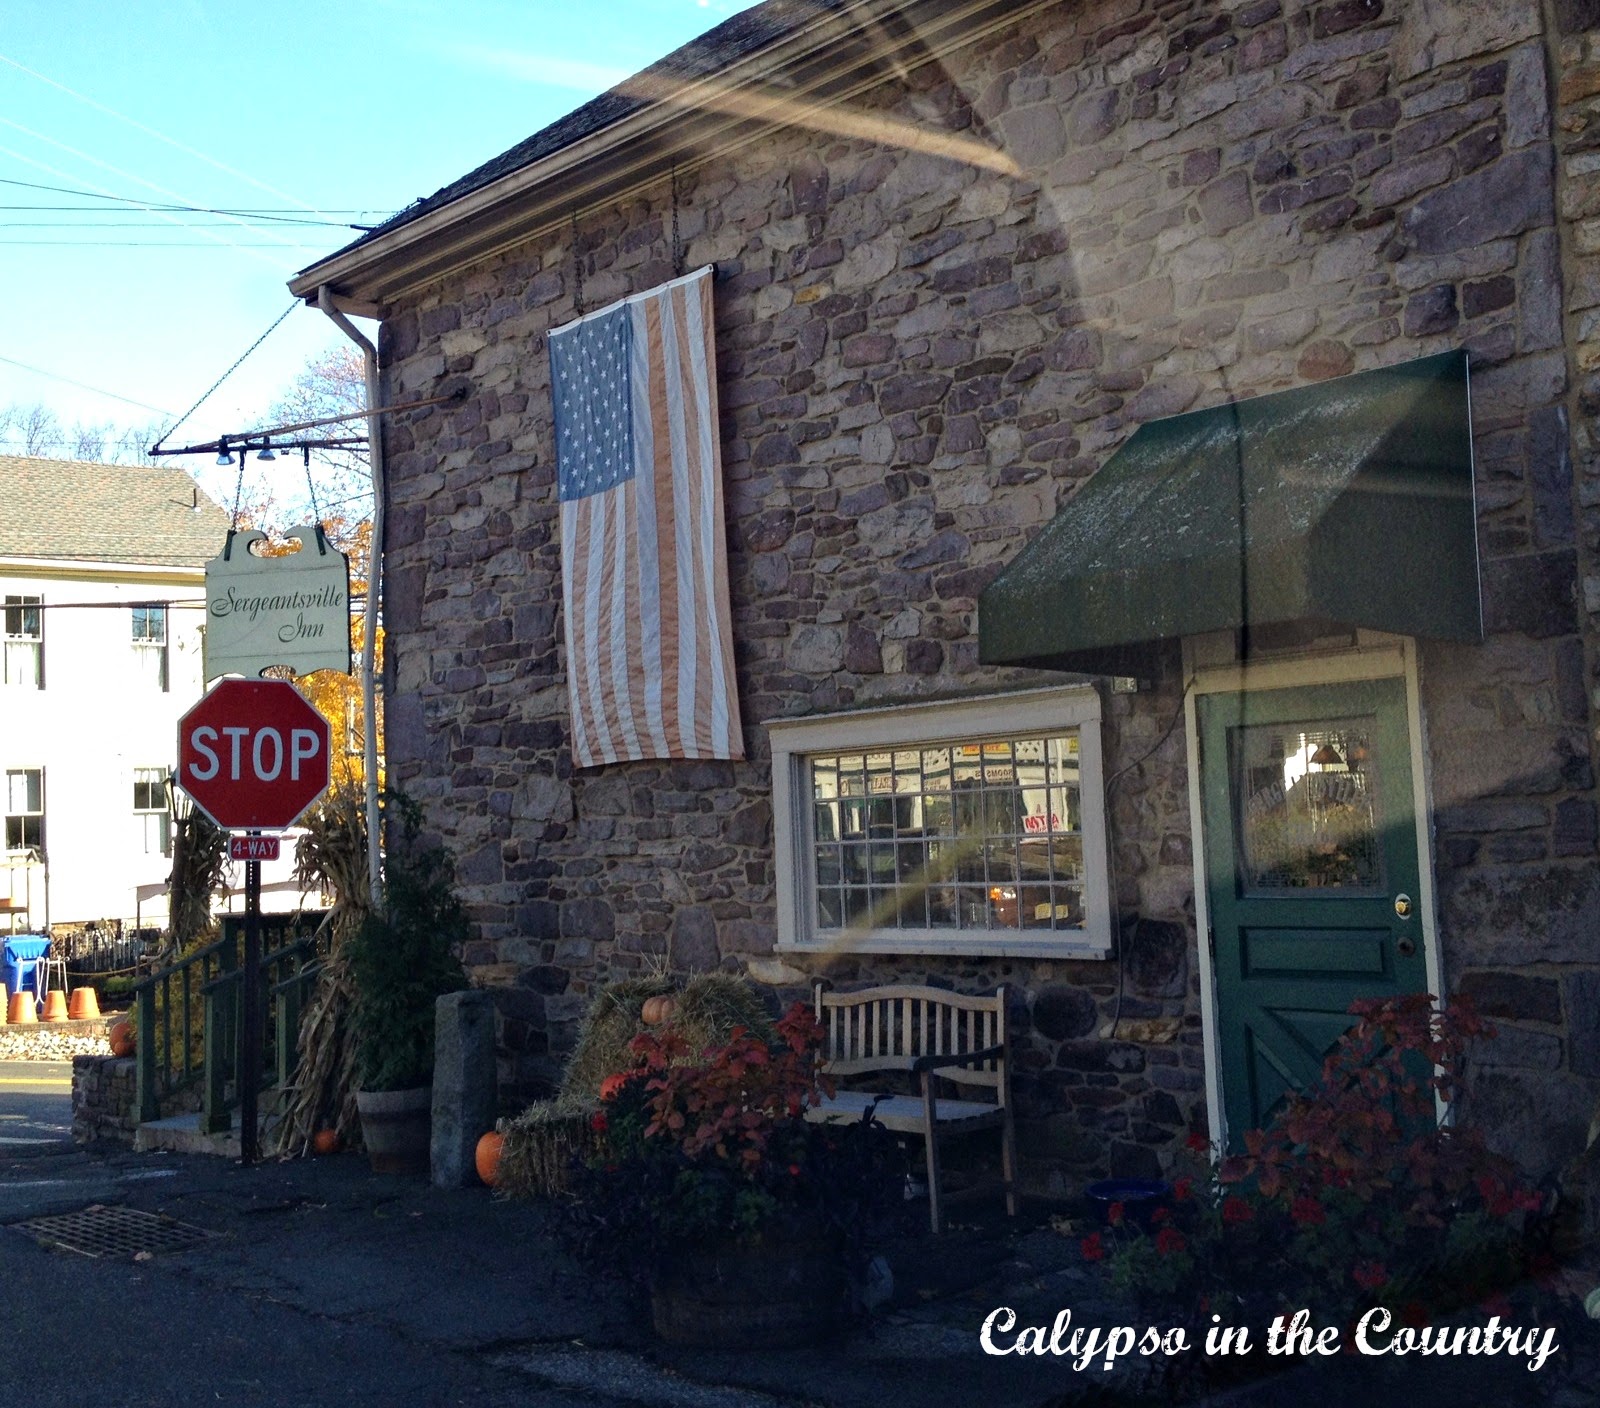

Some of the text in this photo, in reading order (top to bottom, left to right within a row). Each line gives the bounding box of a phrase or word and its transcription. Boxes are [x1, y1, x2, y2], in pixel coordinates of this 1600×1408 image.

[210, 584, 344, 621] Sergeantsville
[278, 613, 324, 643] Inn
[189, 726, 320, 781] STOP
[233, 840, 276, 856] 4-WAY
